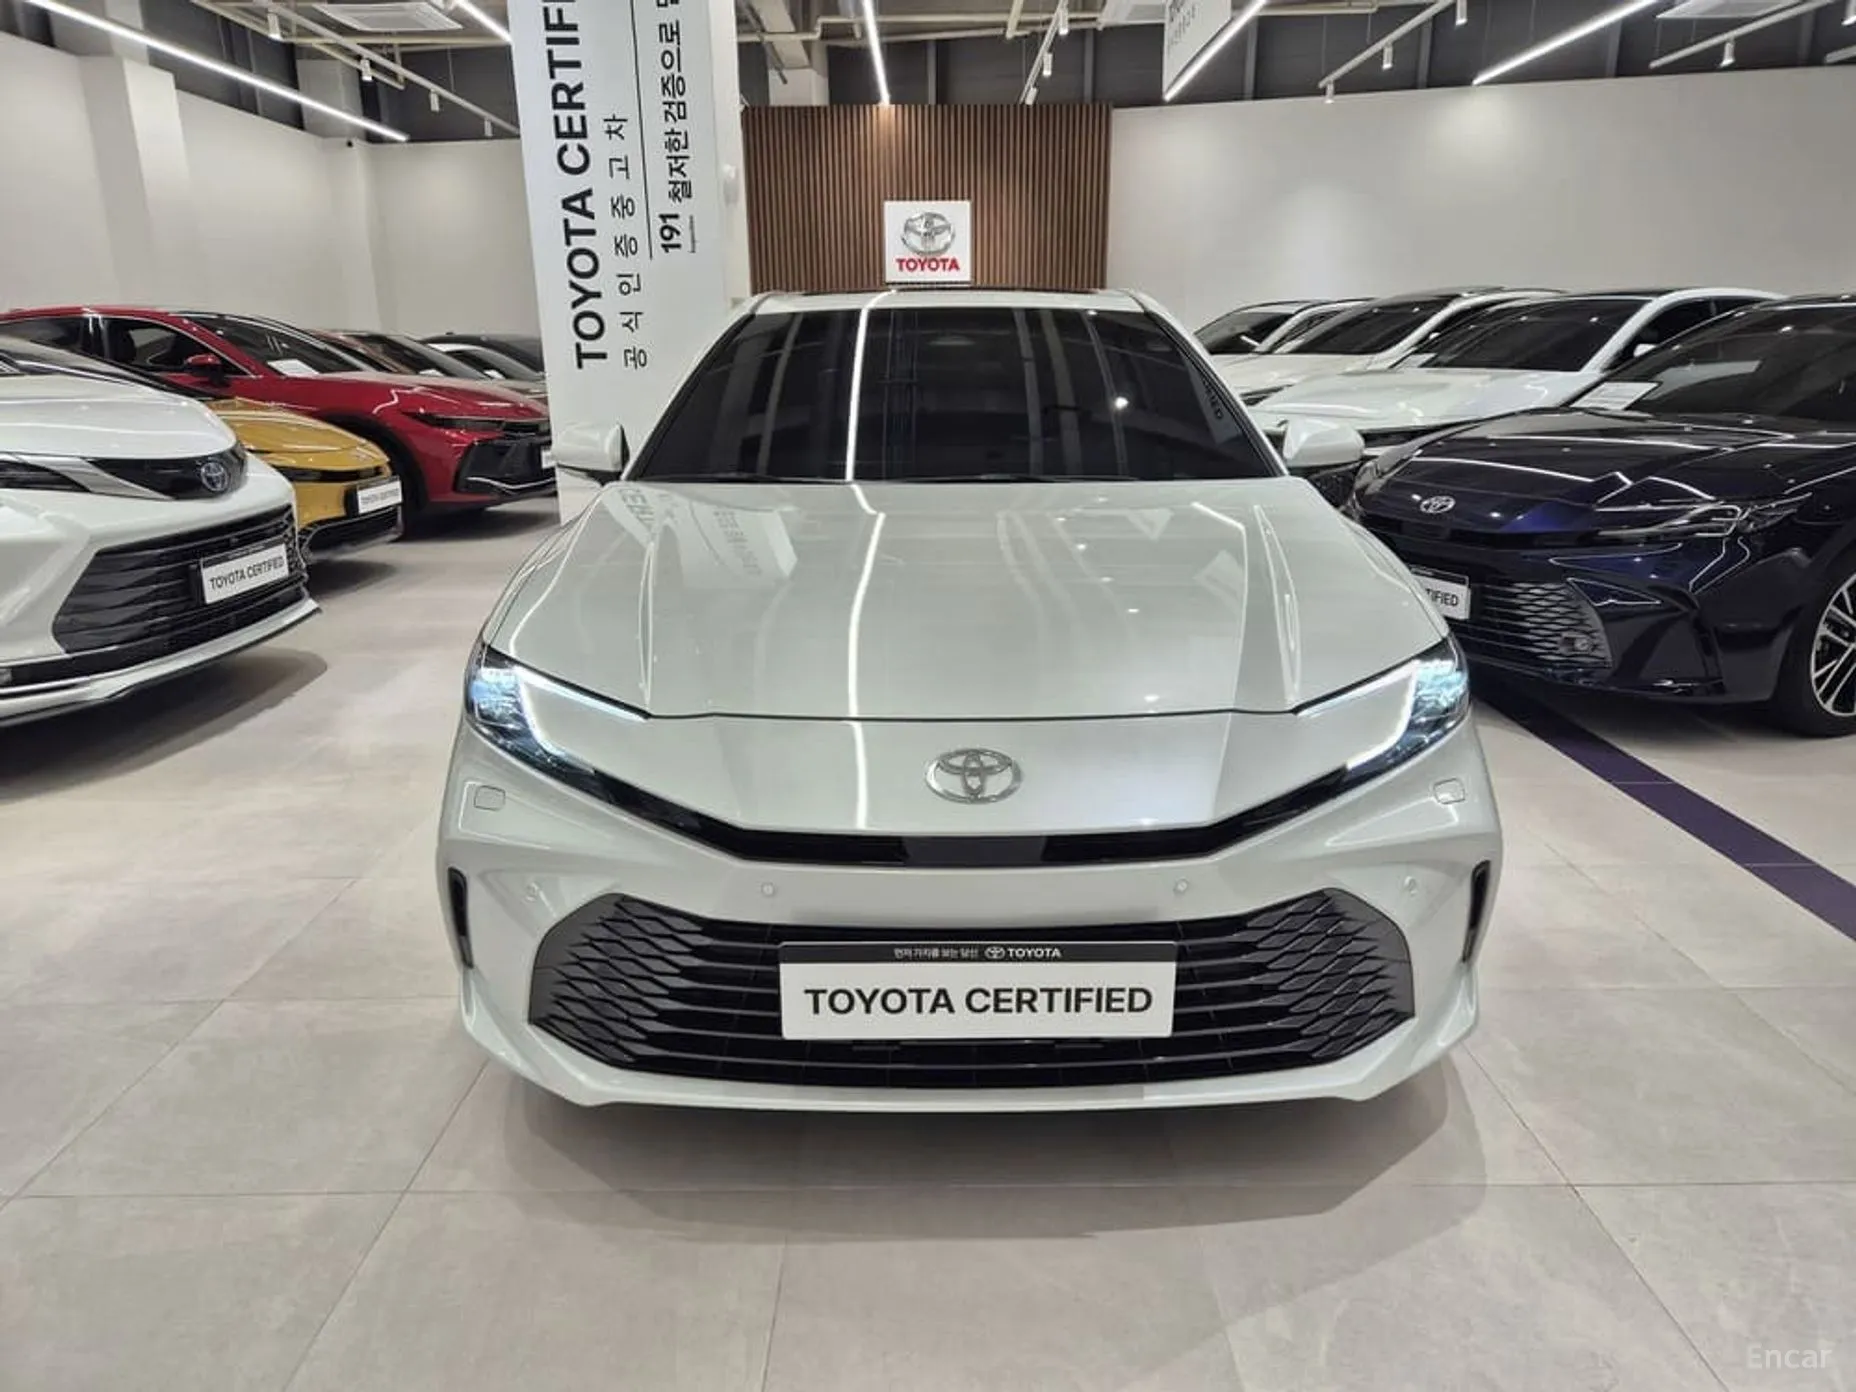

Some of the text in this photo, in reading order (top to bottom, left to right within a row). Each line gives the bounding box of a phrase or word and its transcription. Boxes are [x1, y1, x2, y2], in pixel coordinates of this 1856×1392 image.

[658, 19, 688, 124] 검증으로
[664, 127, 693, 204] 철저한
[658, 213, 682, 253] 191
[895, 256, 960, 272] TOYOTA
[561, 187, 608, 370] TOYOTA
[209, 569, 246, 590] TOYOTA
[1424, 587, 1459, 607] TIFIED
[1007, 947, 1062, 958] TOYOTA
[804, 987, 1153, 1015] TOYOTA CERTIFIED
